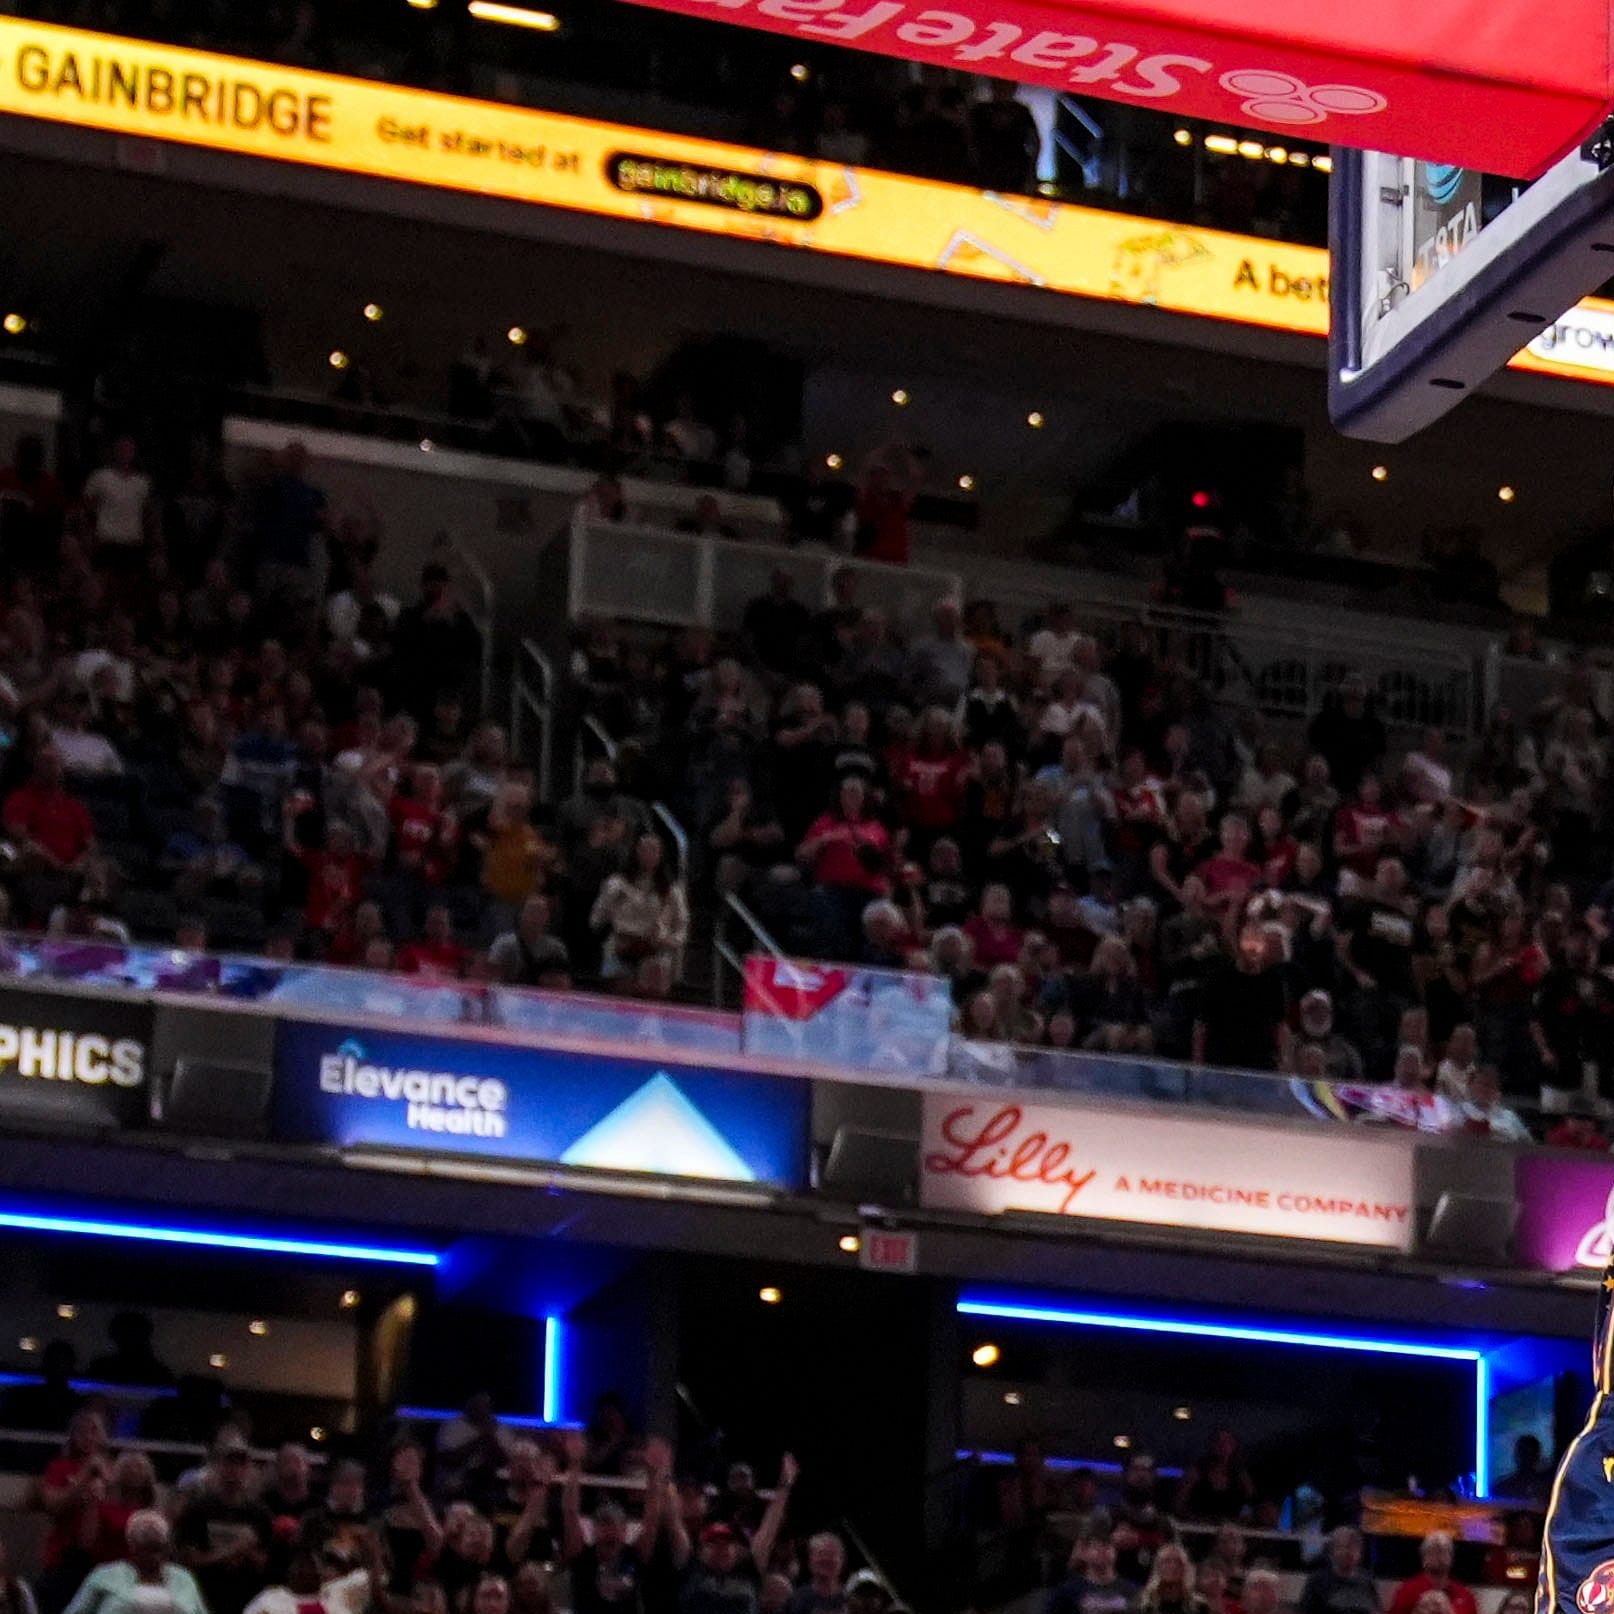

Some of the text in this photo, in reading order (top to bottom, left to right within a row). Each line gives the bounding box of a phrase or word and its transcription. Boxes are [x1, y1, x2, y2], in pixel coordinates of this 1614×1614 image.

[15, 44, 334, 144] GAINBRIDGE
[1233, 260, 1259, 292] A
[319, 1051, 509, 1109] Elevance
[405, 1103, 508, 1140] Health
[924, 1102, 1408, 1226] Lilly A MEDICINE COMPANY
